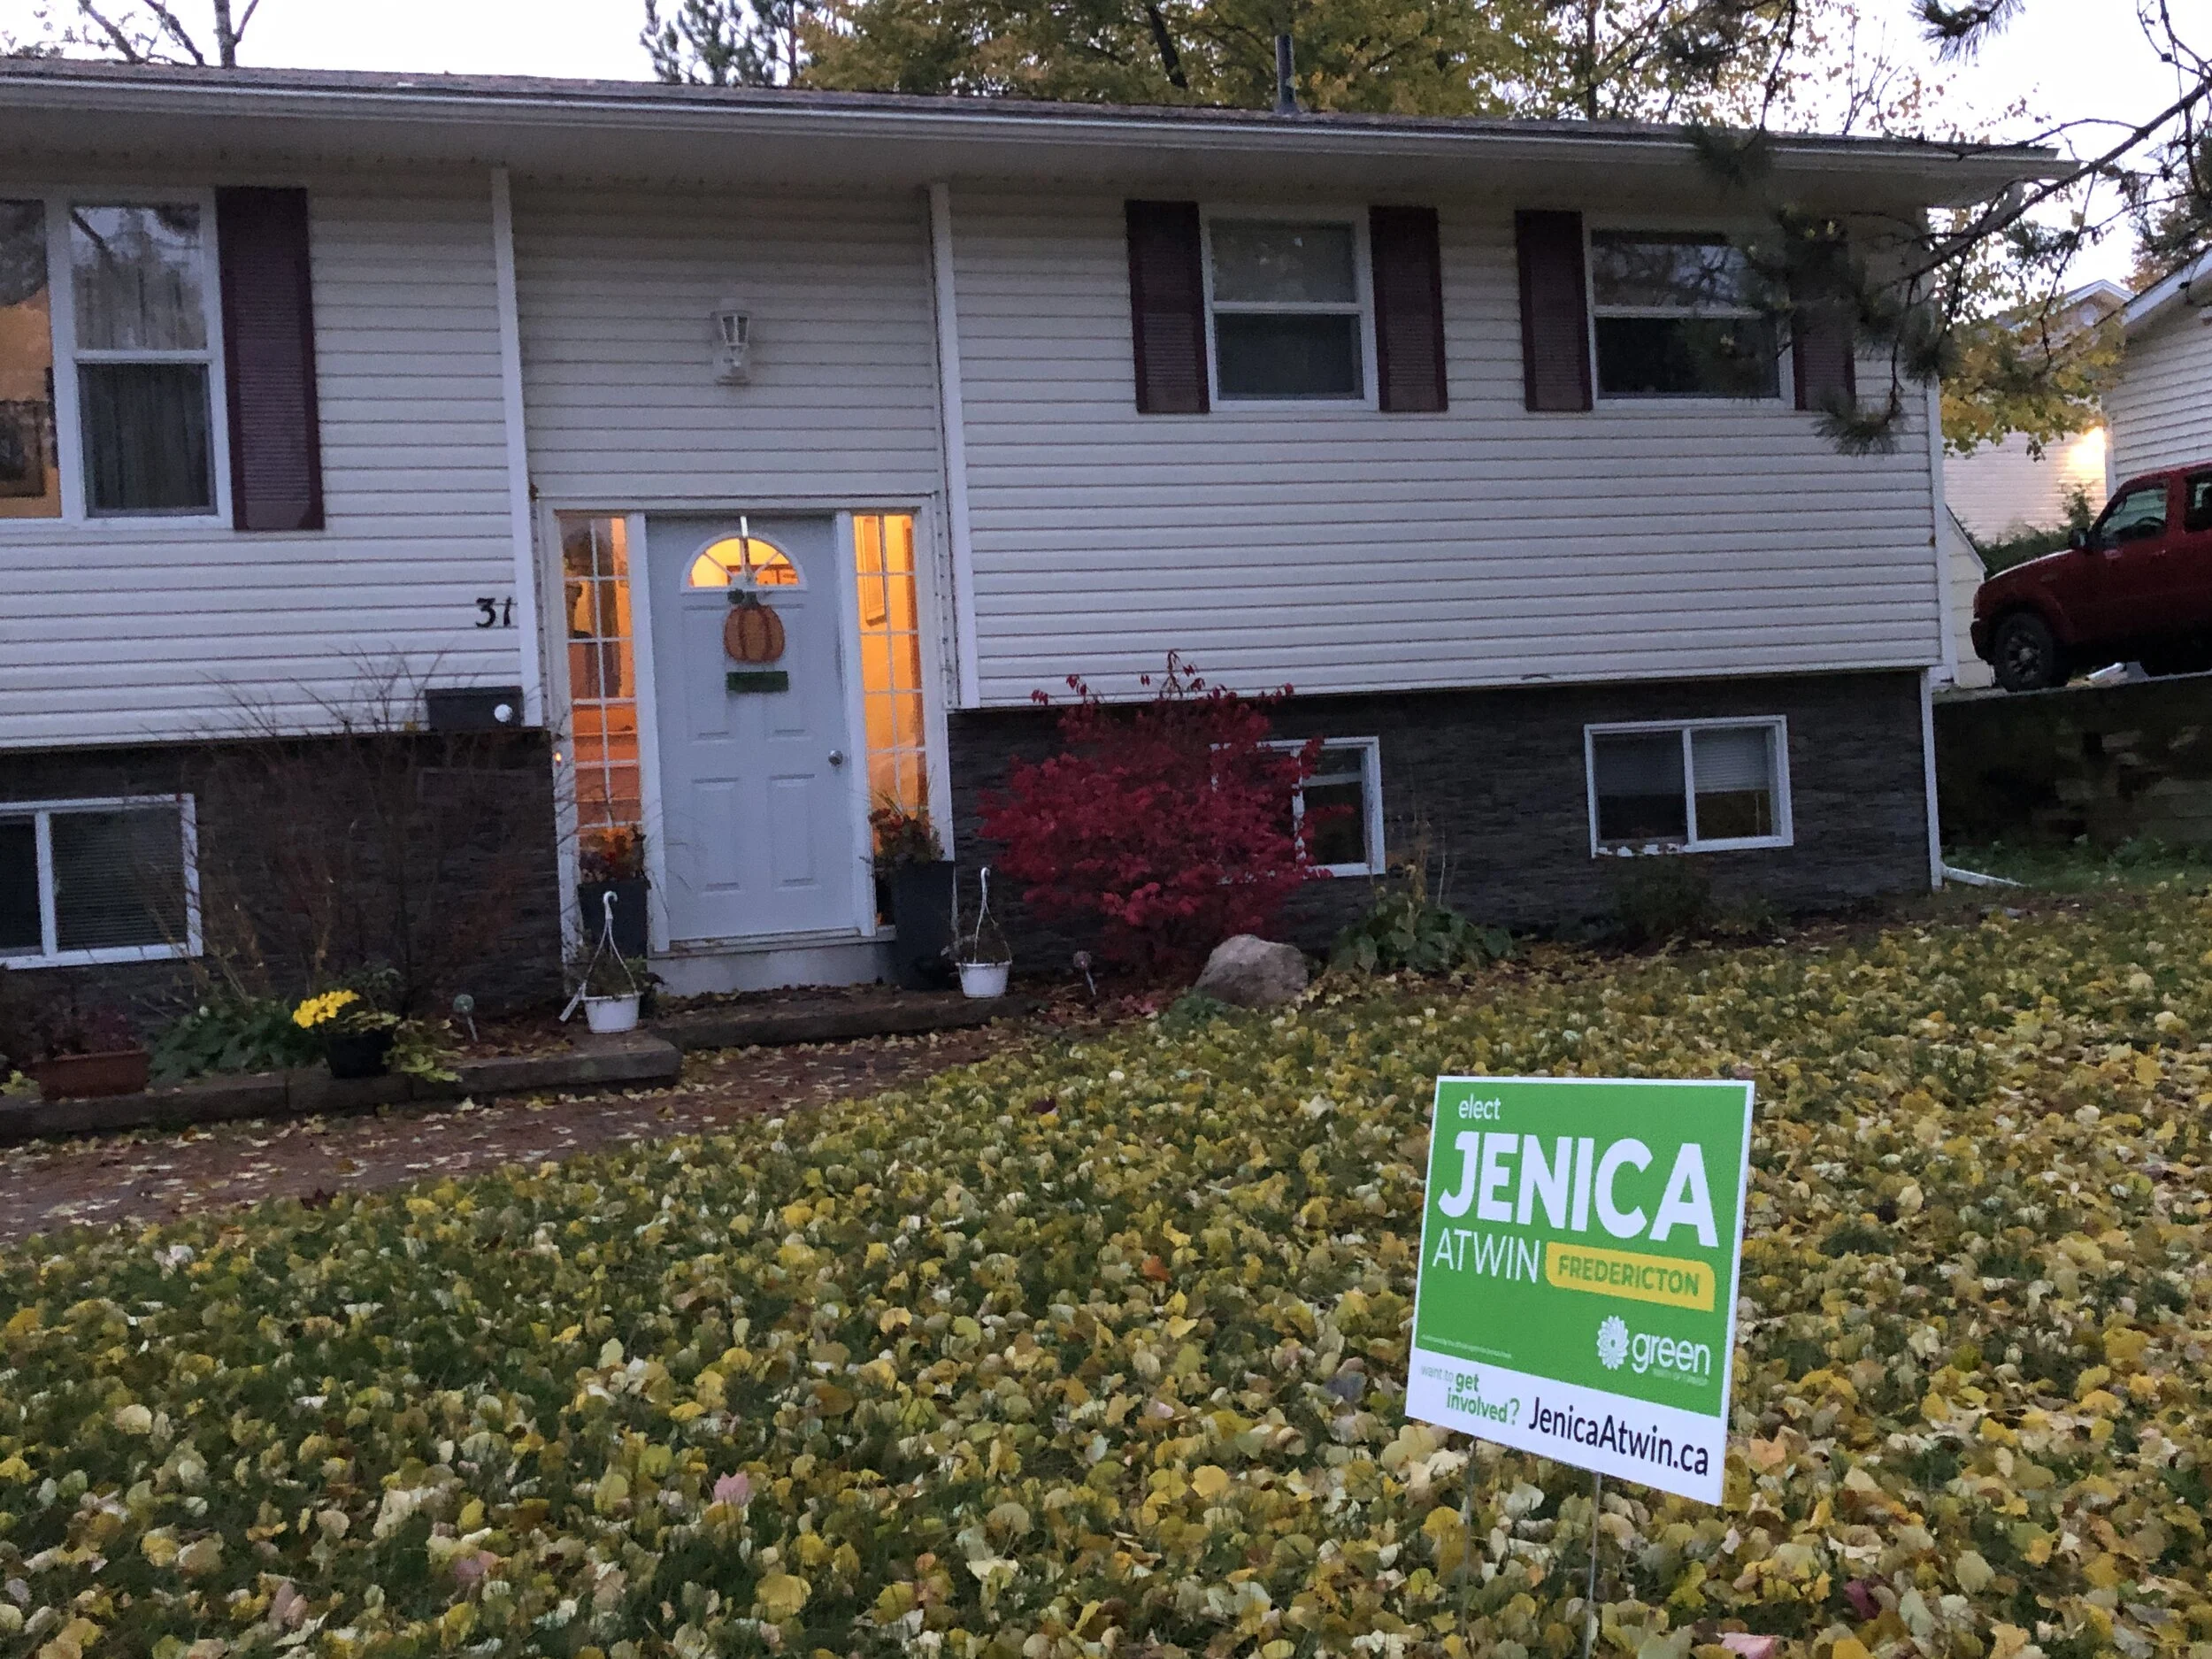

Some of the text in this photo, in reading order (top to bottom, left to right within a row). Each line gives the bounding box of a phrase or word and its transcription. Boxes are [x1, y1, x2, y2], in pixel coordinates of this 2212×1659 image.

[475, 595, 512, 628] 31
[1458, 1094, 1501, 1121] elect
[1438, 1131, 1720, 1248] JENICA
[1432, 1227, 1701, 1297] ATWIN FREDERICTON
[1632, 1333, 1711, 1376] green
[1421, 1365, 1480, 1393] want to get
[1447, 1386, 1521, 1425] involved?
[1529, 1396, 1709, 1477] JenicaAtwin.ca
